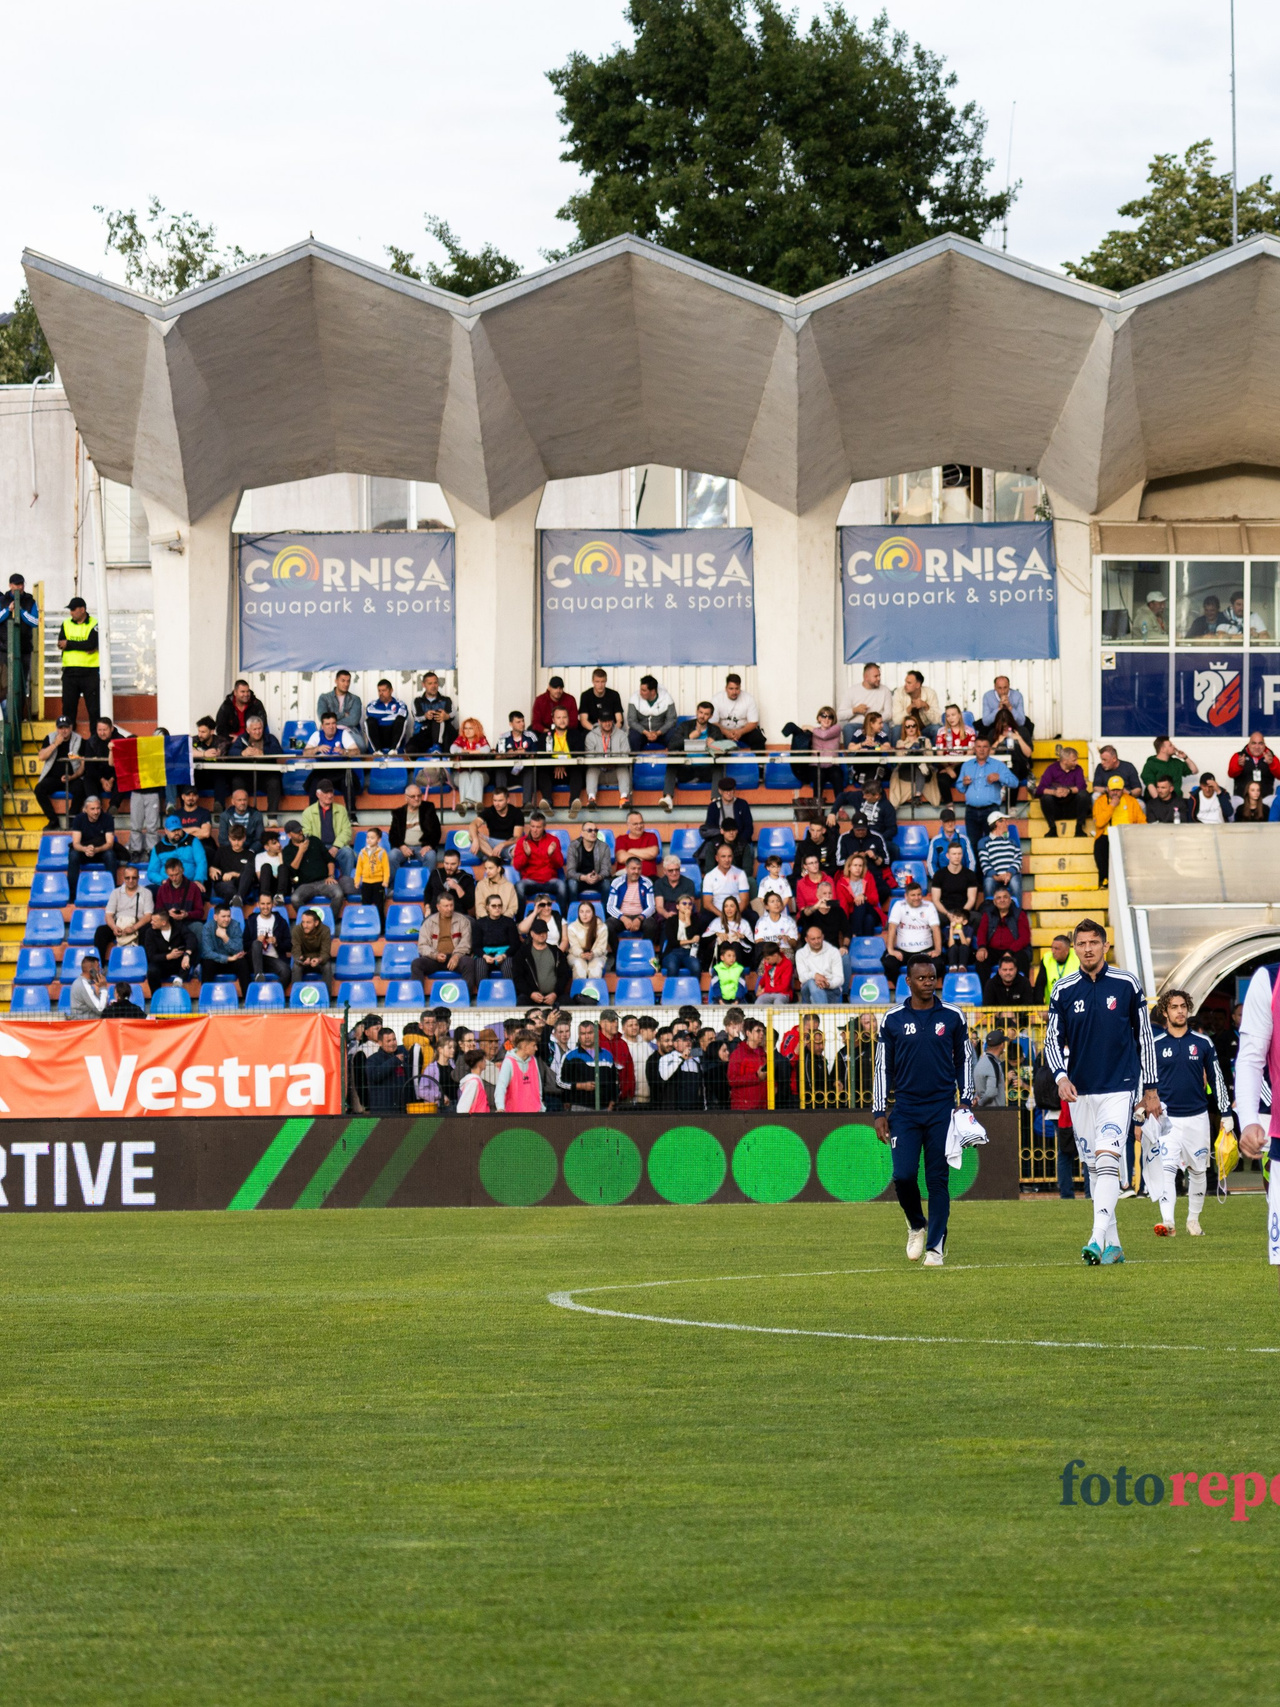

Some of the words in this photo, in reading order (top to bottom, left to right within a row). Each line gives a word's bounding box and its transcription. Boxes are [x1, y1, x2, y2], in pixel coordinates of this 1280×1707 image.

[547, 593, 654, 613] aquapark
[665, 593, 678, 609] &
[688, 592, 752, 612] sports
[848, 588, 955, 609] aquapark
[966, 587, 979, 603] &
[989, 585, 1054, 606] sports
[245, 597, 352, 618] aquapark
[363, 597, 376, 613] &
[386, 596, 450, 617] sports
[1060, 822, 1067, 835] 7
[1061, 894, 1068, 907] 5
[1074, 1000, 1085, 1013] 32
[904, 1023, 916, 1035] 28
[1162, 1048, 1173, 1058] 66
[84, 1055, 326, 1112] Vestra
